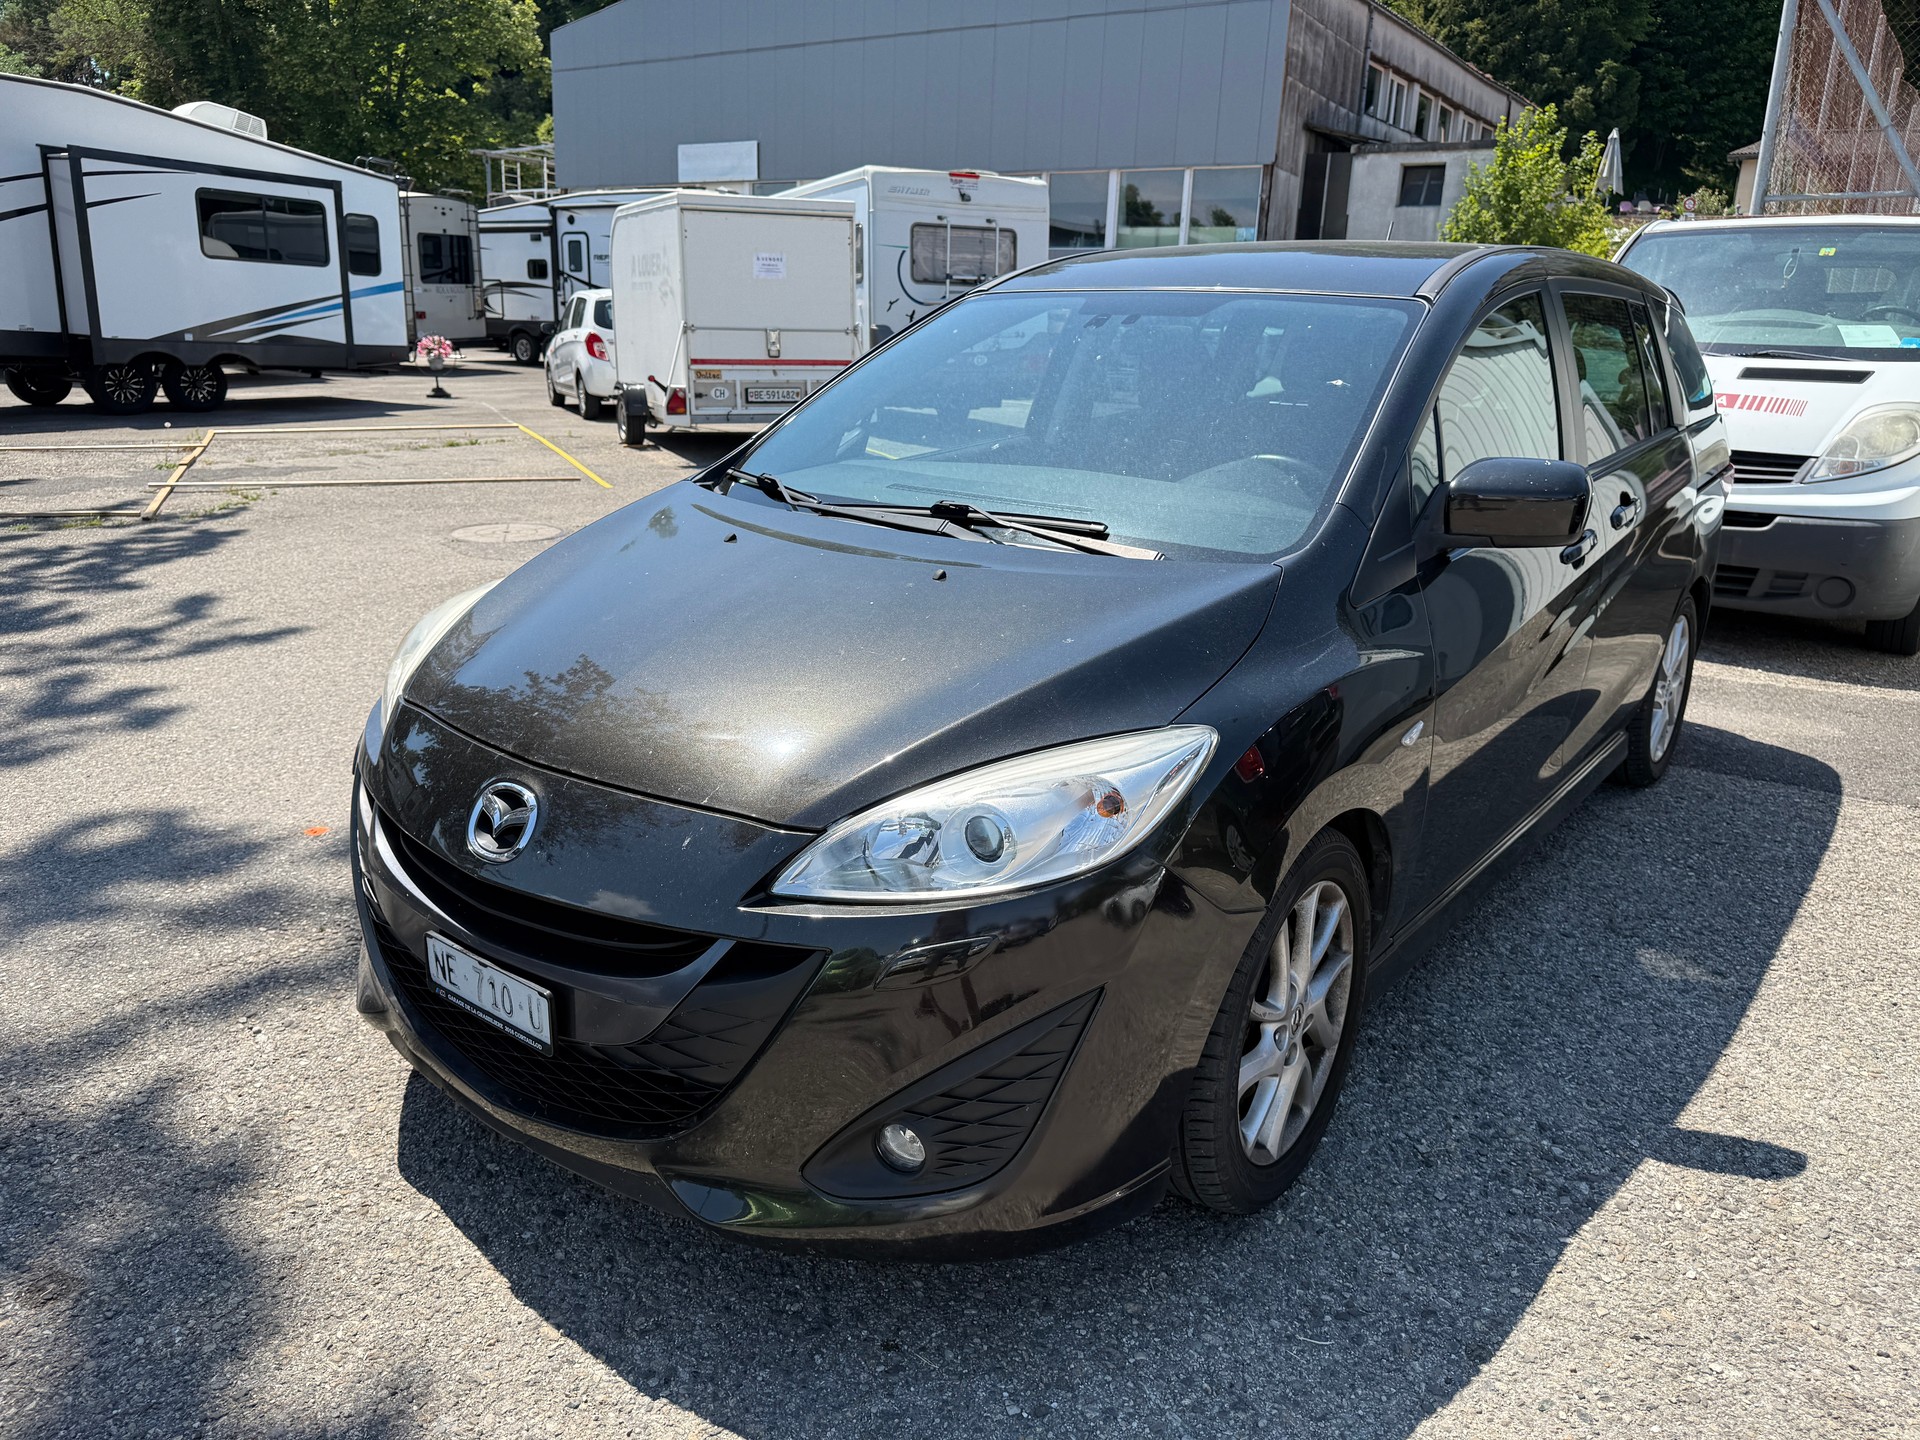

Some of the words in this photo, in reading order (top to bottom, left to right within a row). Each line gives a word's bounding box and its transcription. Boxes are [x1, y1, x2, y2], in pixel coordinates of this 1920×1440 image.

[714, 388, 725, 398] CH
[433, 943, 460, 990] NE
[472, 965, 514, 1018] 710
